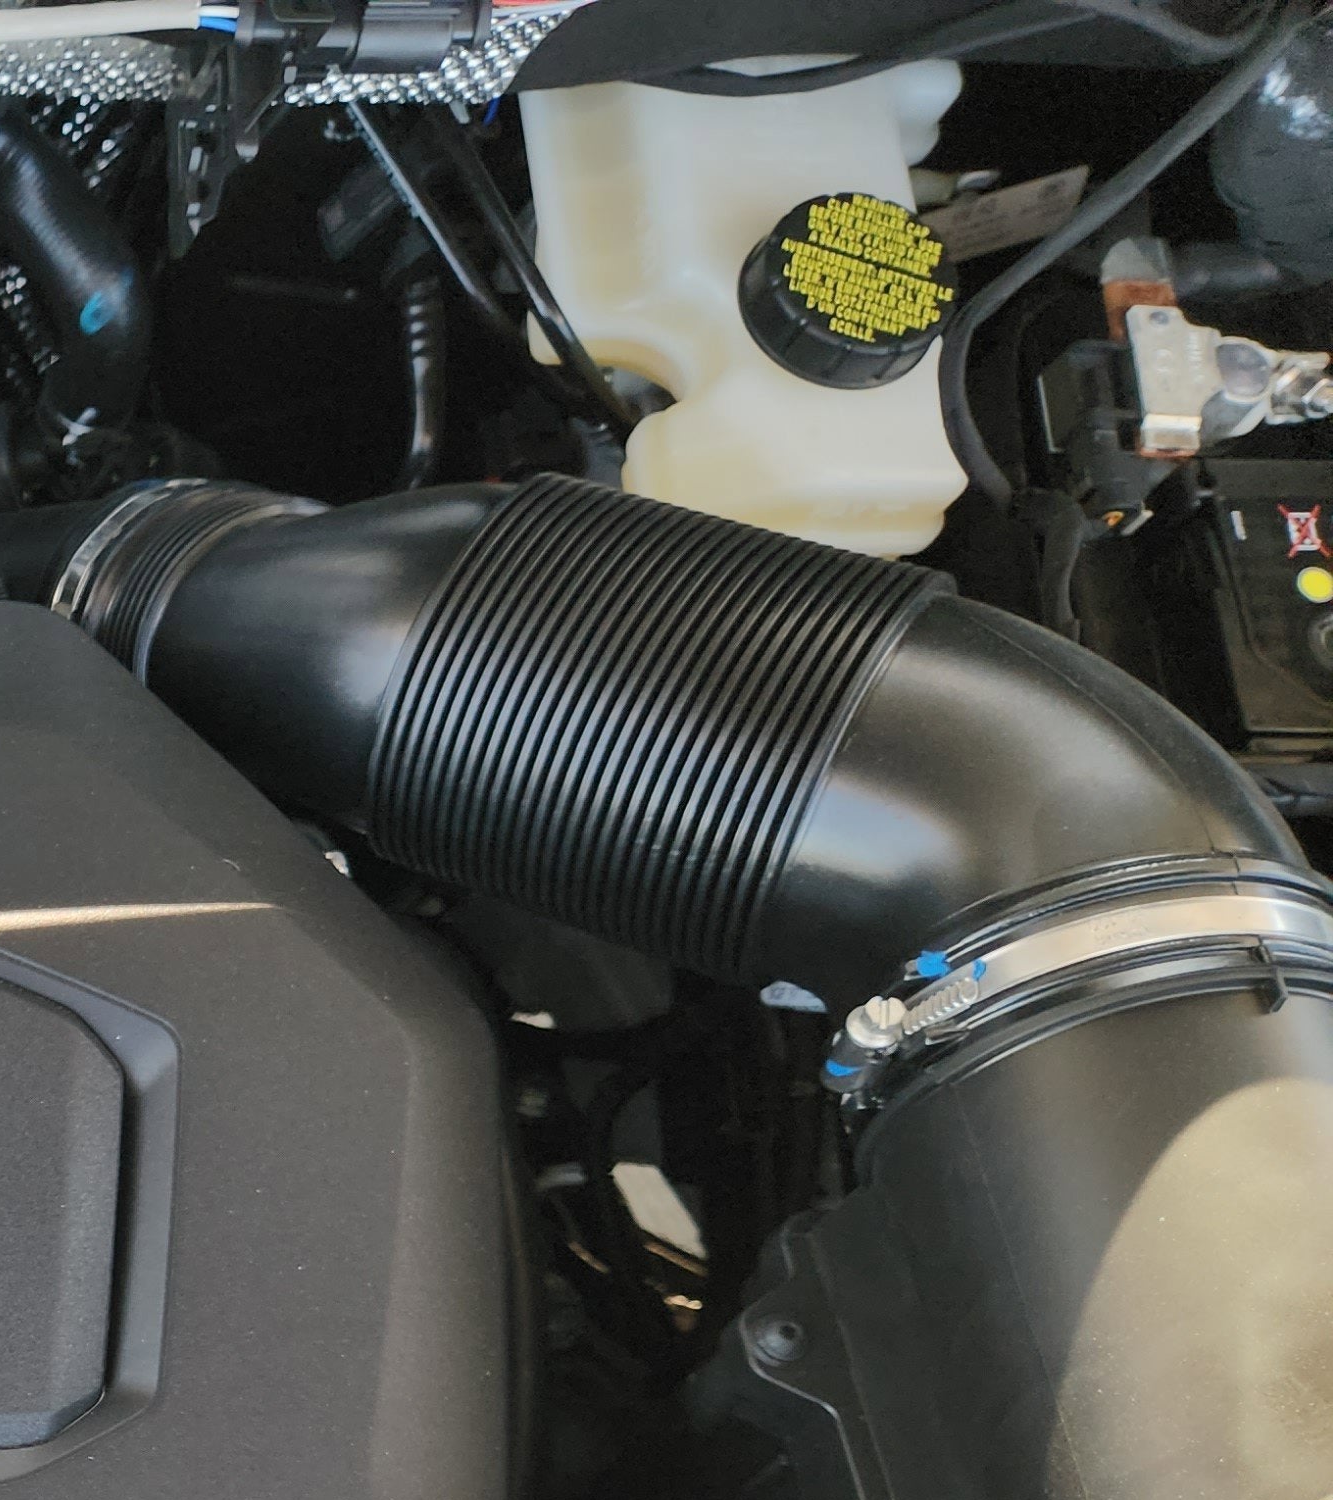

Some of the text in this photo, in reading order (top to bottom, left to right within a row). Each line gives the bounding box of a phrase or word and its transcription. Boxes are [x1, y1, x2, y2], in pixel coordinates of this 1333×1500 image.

[809, 204, 854, 229] BEFORE
[919, 239, 943, 256] USE
[827, 198, 930, 238] CLEAN FILLER CAP
[808, 216, 840, 236] ONLY
[872, 236, 906, 258] FLUID
[907, 247, 940, 268] FROM
[808, 230, 818, 242] A
[819, 232, 863, 257] SEALED
[789, 279, 834, 302] LIQUIDE
[791, 252, 848, 280] BOUCHON
[848, 270, 887, 294] AVANT
[889, 283, 906, 299] DE
[877, 268, 938, 297] NETTOYER
[938, 286, 954, 302] LE
[836, 305, 907, 337] CONTENANT
[898, 300, 923, 317] QUE
[923, 307, 941, 323] DU
